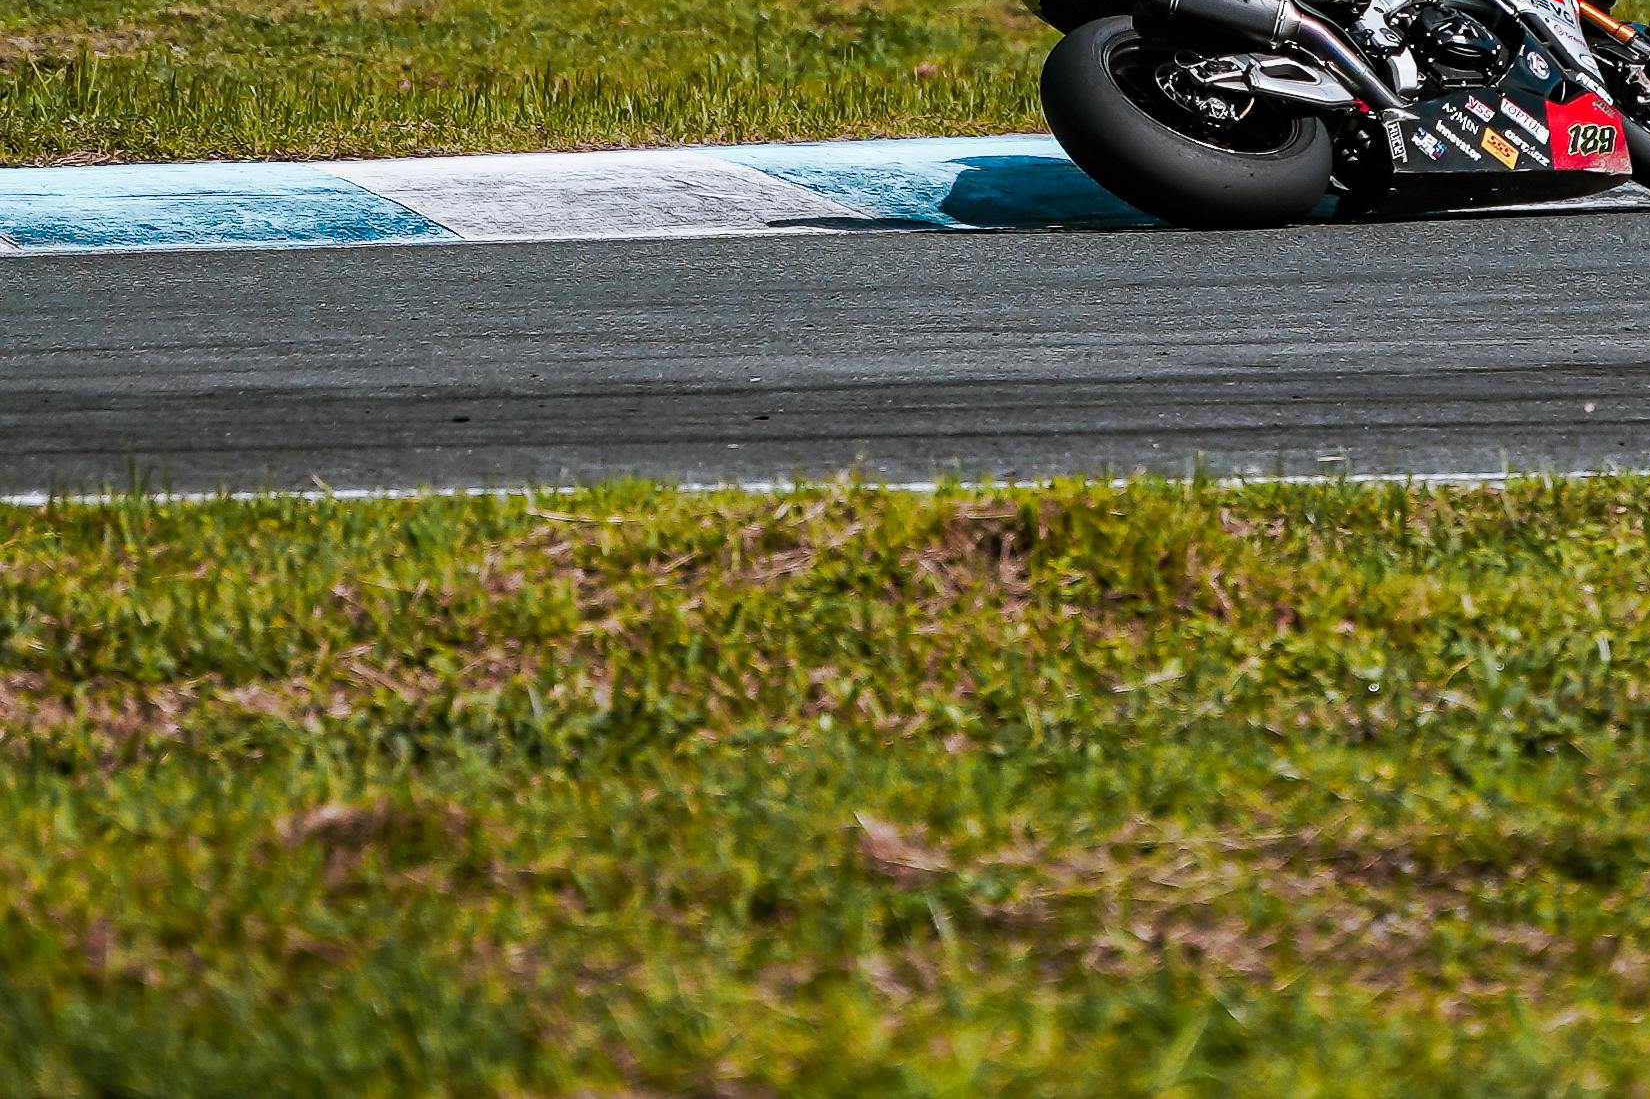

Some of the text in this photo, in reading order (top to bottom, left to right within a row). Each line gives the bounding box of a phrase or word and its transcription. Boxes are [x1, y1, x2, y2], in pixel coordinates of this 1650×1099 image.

[1465, 95, 1494, 120] YSS
[1502, 100, 1545, 136] TOPTUL
[1567, 121, 1618, 157] 189
